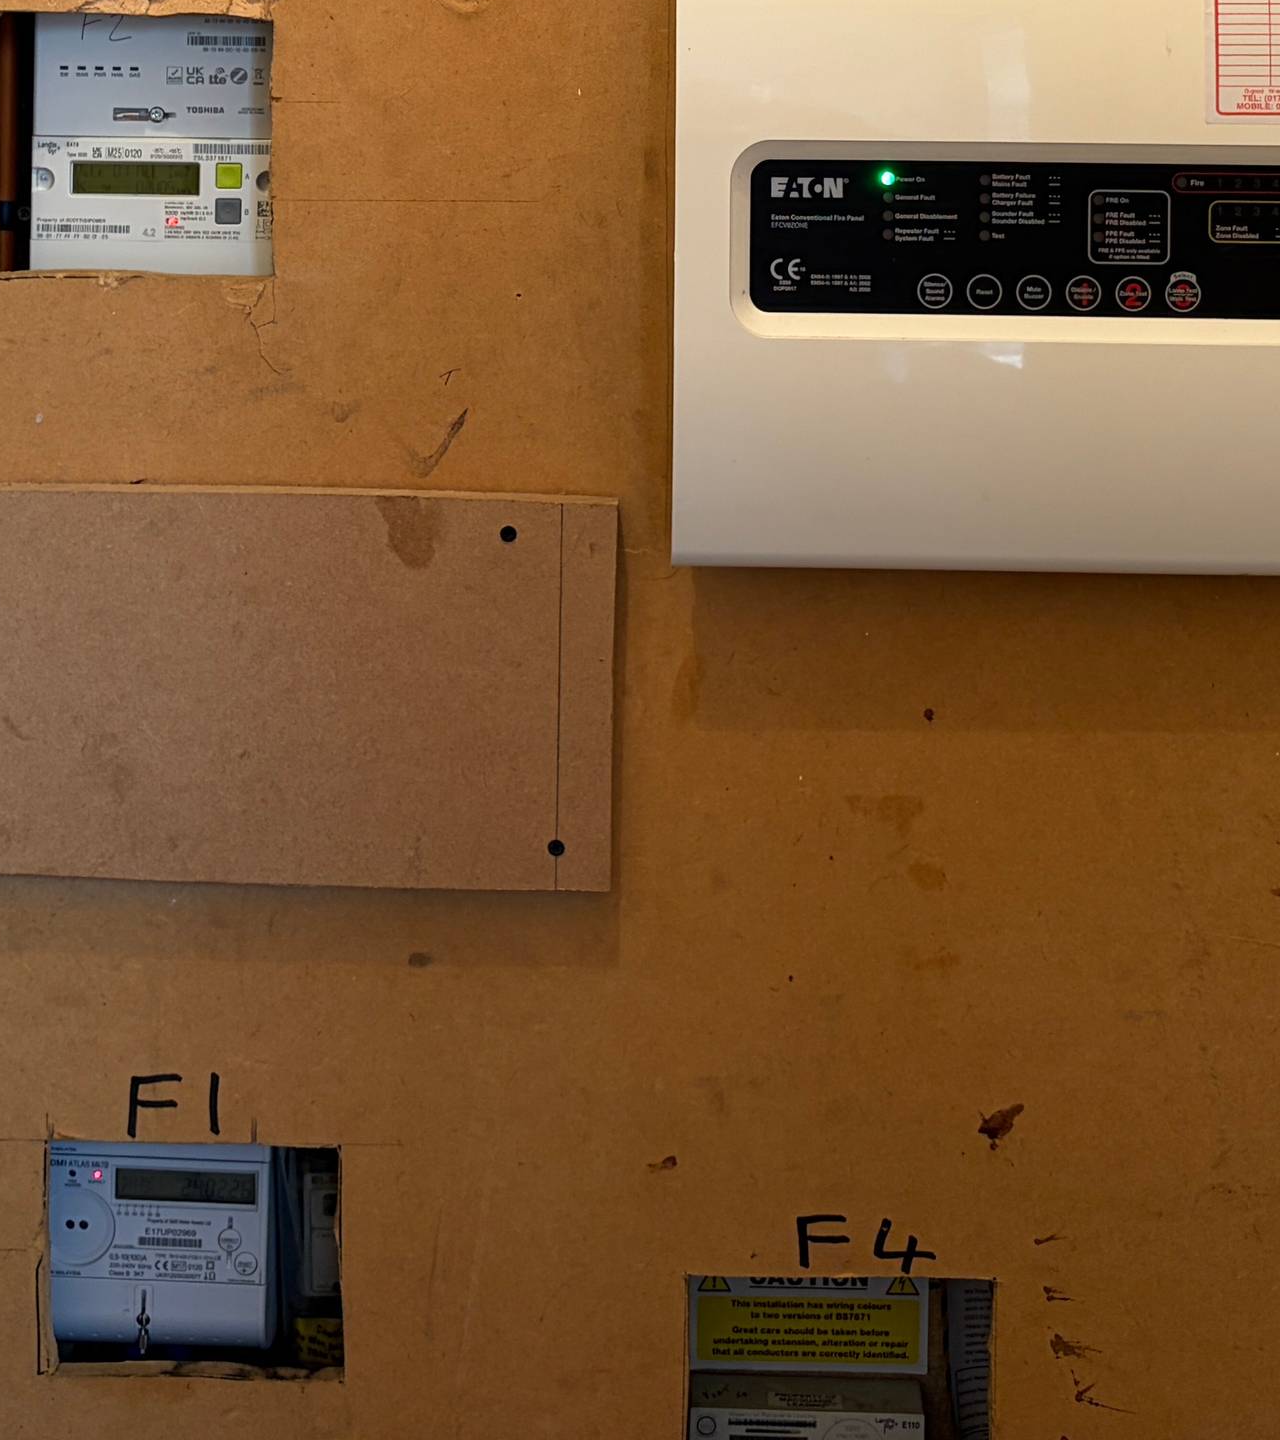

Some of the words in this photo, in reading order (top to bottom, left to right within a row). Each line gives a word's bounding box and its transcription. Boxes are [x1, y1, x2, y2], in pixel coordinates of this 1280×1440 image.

[186, 66, 204, 76] UK
[186, 76, 205, 85] CA
[1242, 94, 1263, 102] TEL:
[186, 106, 225, 114] TOSHIBA
[124, 148, 143, 158] 0120
[770, 176, 844, 199] EATON
[1190, 179, 1205, 187] Fire
[770, 213, 790, 221] Eaton
[790, 213, 833, 221] Conventional
[1215, 224, 1231, 232] Zone
[1231, 224, 1248, 232] Fault
[1215, 232, 1231, 240] Zone
[797, 1214, 936, 1274] F4
[731, 1299, 751, 1308] This
[753, 1300, 804, 1309] installation
[807, 1301, 823, 1310] has
[826, 1301, 855, 1312] wiring
[857, 1302, 892, 1311] colours
[762, 1312, 780, 1320] two
[782, 1312, 821, 1320] versions
[824, 1312, 833, 1320] of
[731, 1325, 758, 1334] Great
[760, 1327, 780, 1335] care
[784, 1326, 814, 1335] should
[816, 1326, 828, 1335] be
[831, 1327, 857, 1336] taken
[860, 1328, 890, 1337] before
[712, 1337, 769, 1347] undertaking
[771, 1338, 818, 1348] extension,
[821, 1339, 867, 1348] alteration
[869, 1340, 878, 1348] or
[881, 1340, 909, 1349] repair
[712, 1347, 731, 1356] that
[733, 1348, 745, 1357] all
[746, 1348, 799, 1357] conductors
[801, 1349, 817, 1358] are
[819, 1349, 861, 1360] correctly
[863, 1350, 910, 1360] identified.
[901, 1421, 920, 1430] E110
